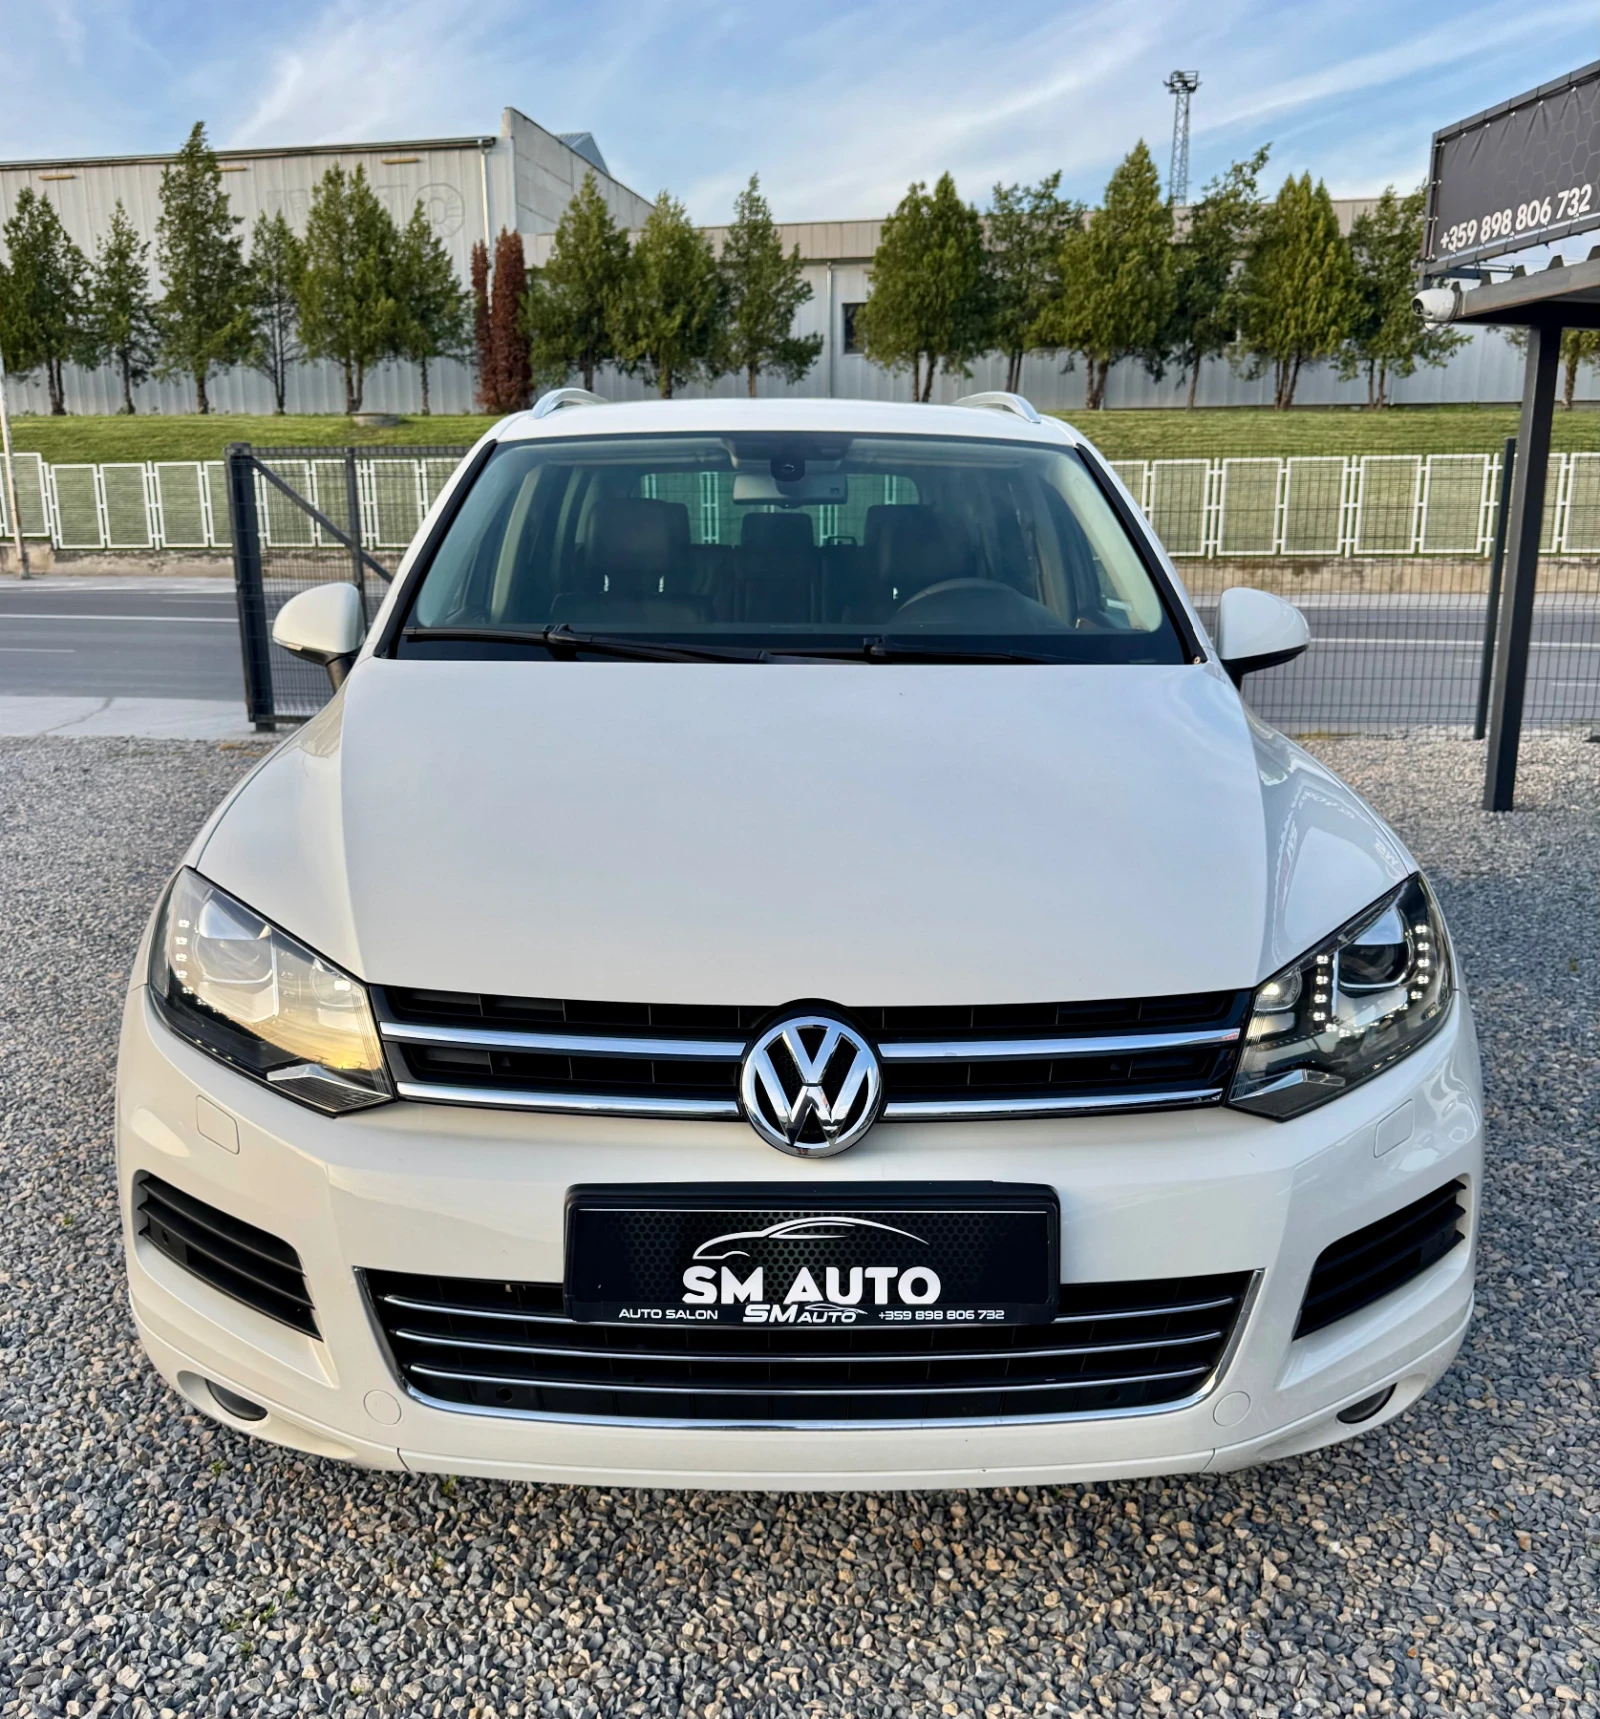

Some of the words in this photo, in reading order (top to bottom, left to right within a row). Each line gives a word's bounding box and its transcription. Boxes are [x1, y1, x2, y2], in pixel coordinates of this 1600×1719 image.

[1440, 218, 1478, 251] +359
[1480, 208, 1513, 243] 898
[1515, 196, 1552, 230] 806
[1556, 183, 1592, 219] 732
[682, 1265, 764, 1305] SM
[783, 1265, 942, 1305] AUTO
[618, 1308, 662, 1319] AUTO
[665, 1309, 719, 1320] SALON
[742, 1303, 799, 1323] SM
[796, 1310, 858, 1324] AUTO
[878, 1310, 912, 1321] +359
[914, 1310, 944, 1321] 898
[946, 1310, 975, 1320] 806
[977, 1309, 1005, 1320] 732
